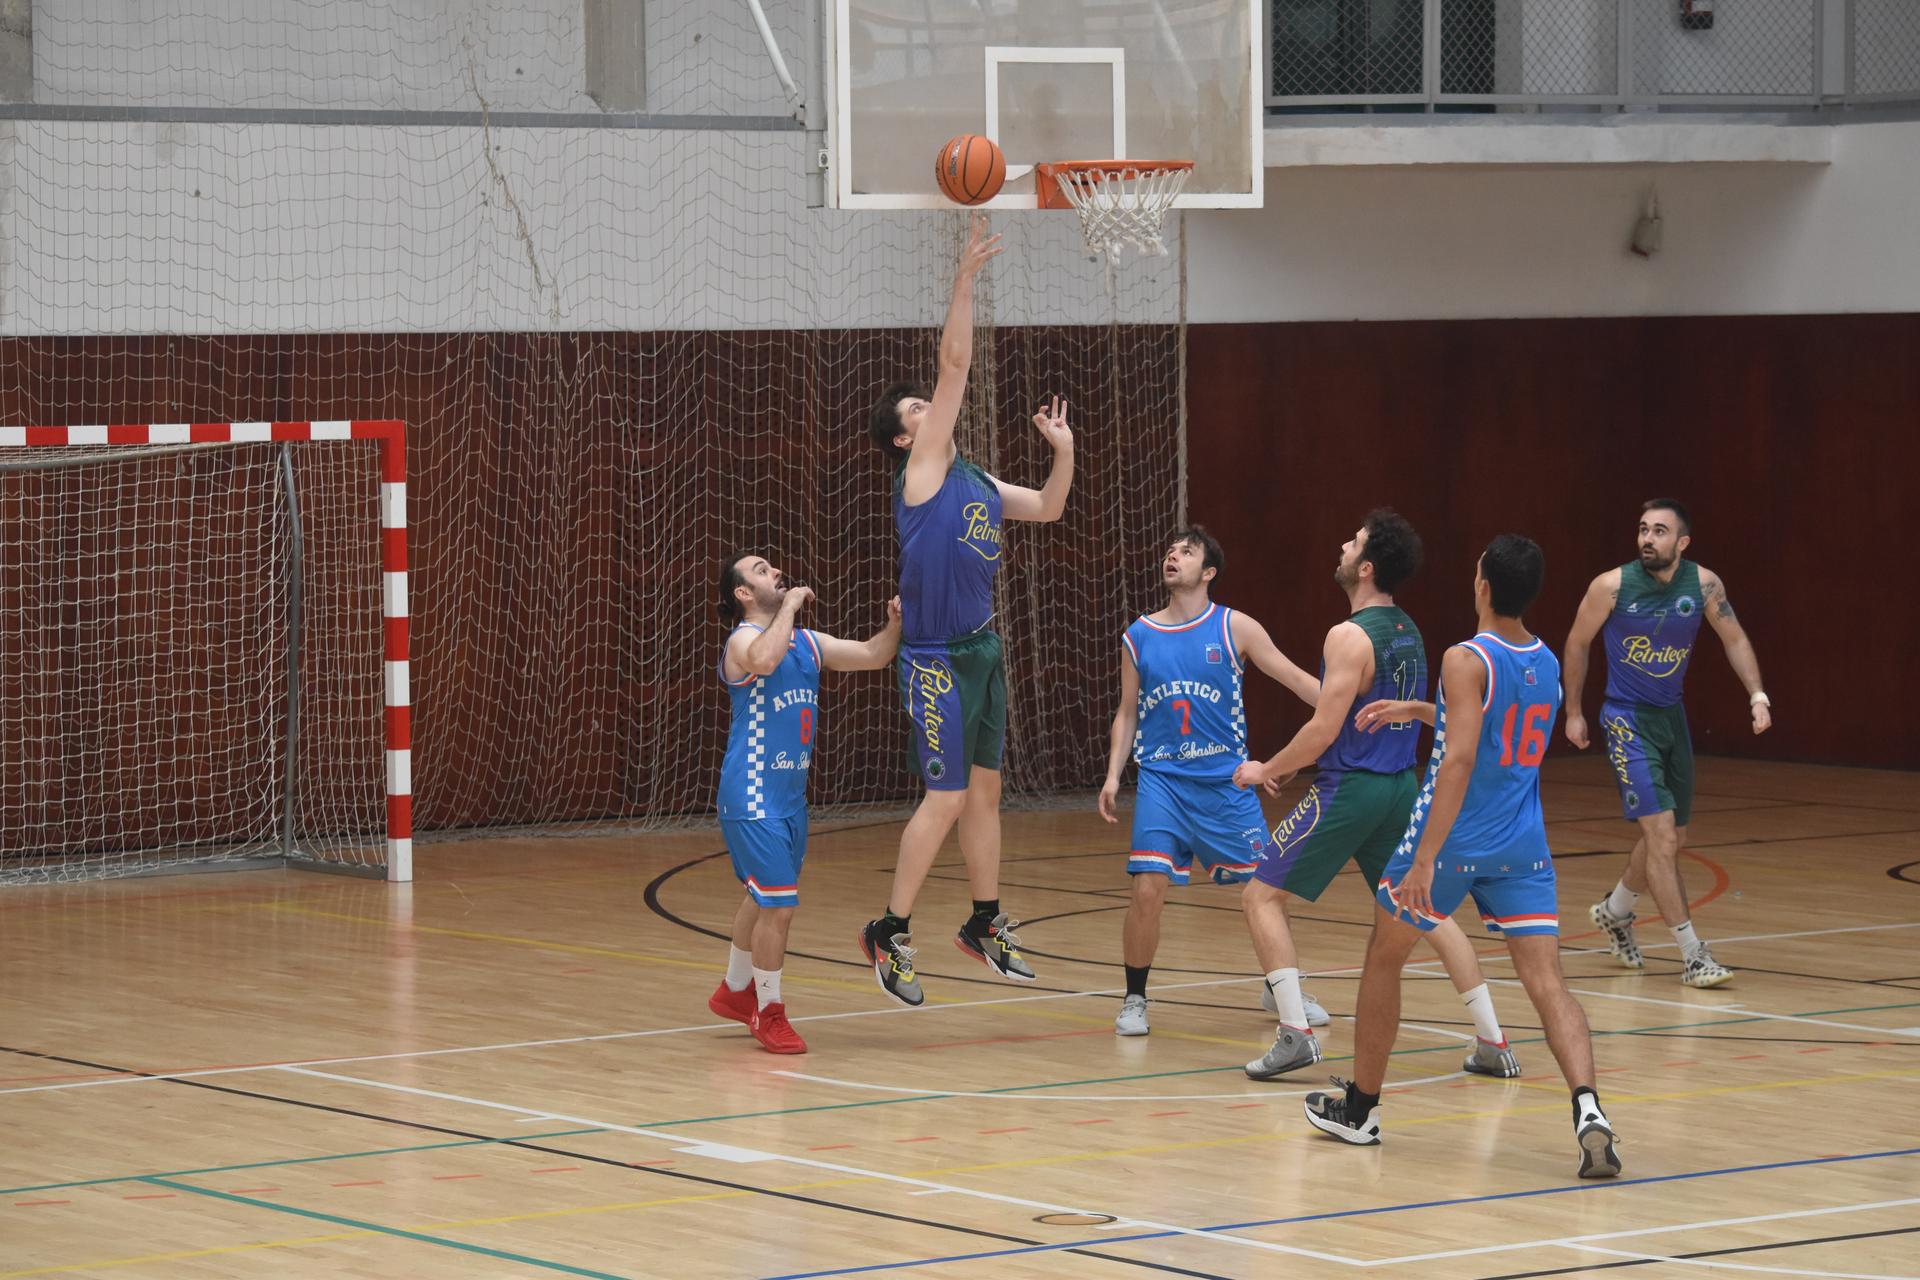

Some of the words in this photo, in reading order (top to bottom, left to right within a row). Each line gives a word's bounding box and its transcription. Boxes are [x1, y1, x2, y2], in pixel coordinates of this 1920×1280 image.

[1653, 609, 1668, 635] 7
[1145, 680, 1221, 710] ATLETICO
[800, 707, 812, 746] 8
[1172, 699, 1191, 736] 7
[1498, 703, 1551, 767] 16
[771, 751, 795, 770] San
[1149, 745, 1173, 762] San
[1177, 741, 1231, 760] Sebastian
